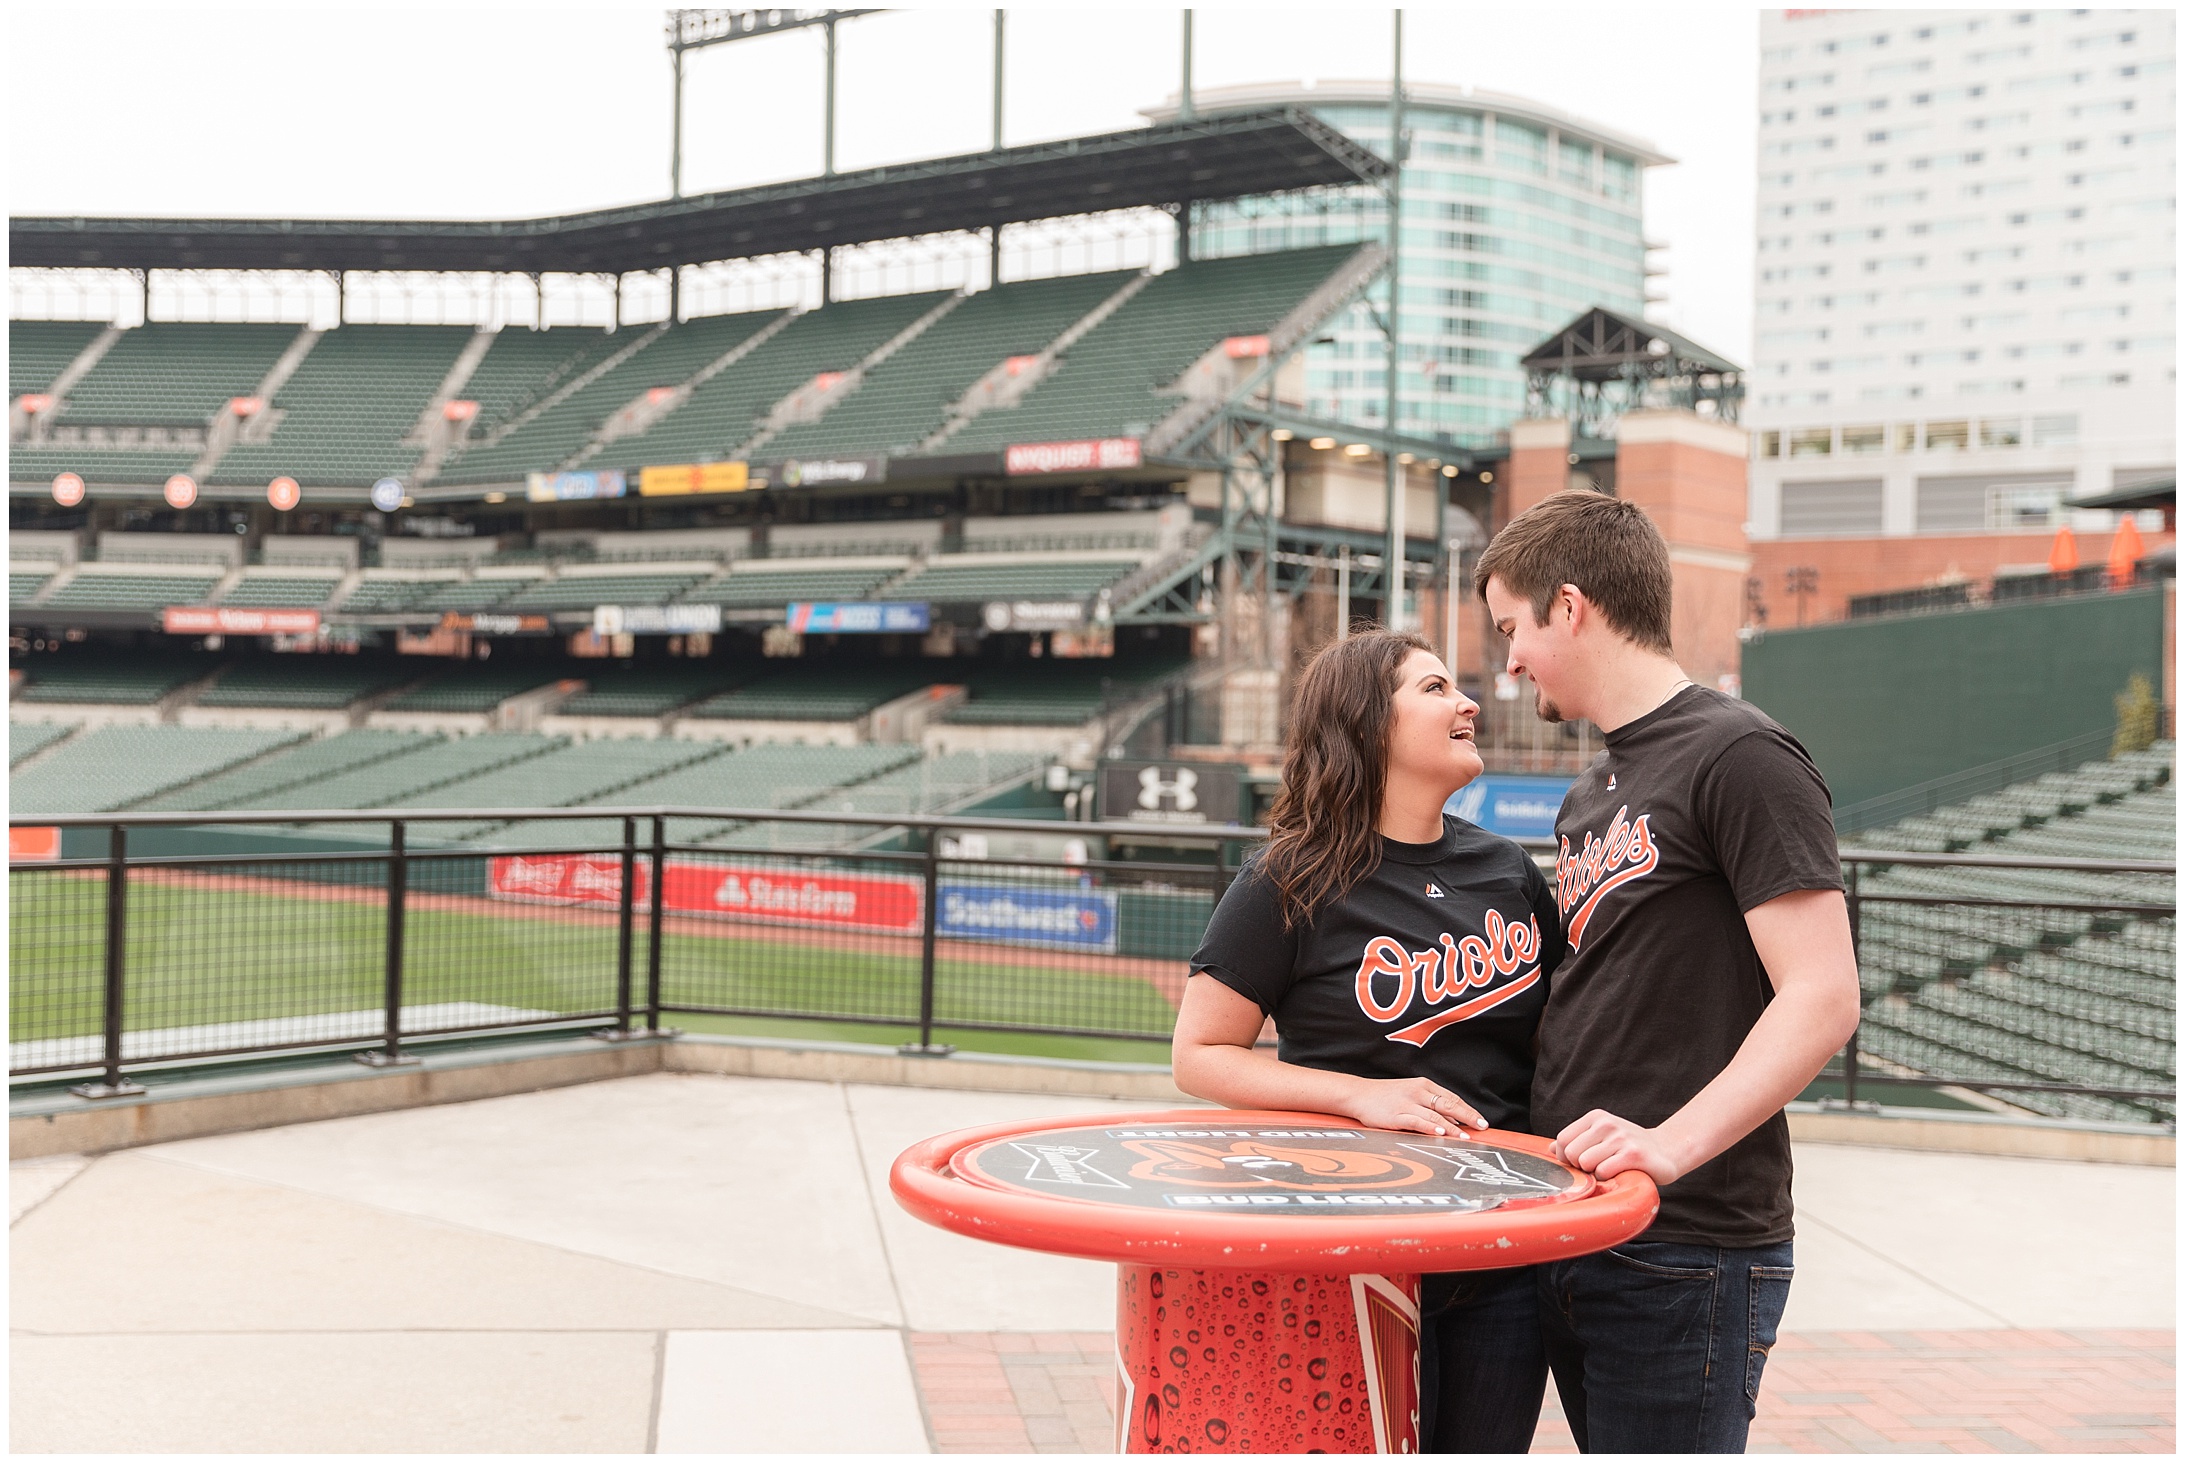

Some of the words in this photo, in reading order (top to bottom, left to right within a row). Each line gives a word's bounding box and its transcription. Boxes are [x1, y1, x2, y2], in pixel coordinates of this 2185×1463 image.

[944, 893, 1080, 936] Southwest
[1117, 1130, 1253, 1138] LIGHT
[1257, 1130, 1357, 1138] BUD
[1172, 1195, 1290, 1205] BUD
[1295, 1195, 1452, 1205] LIGHT
